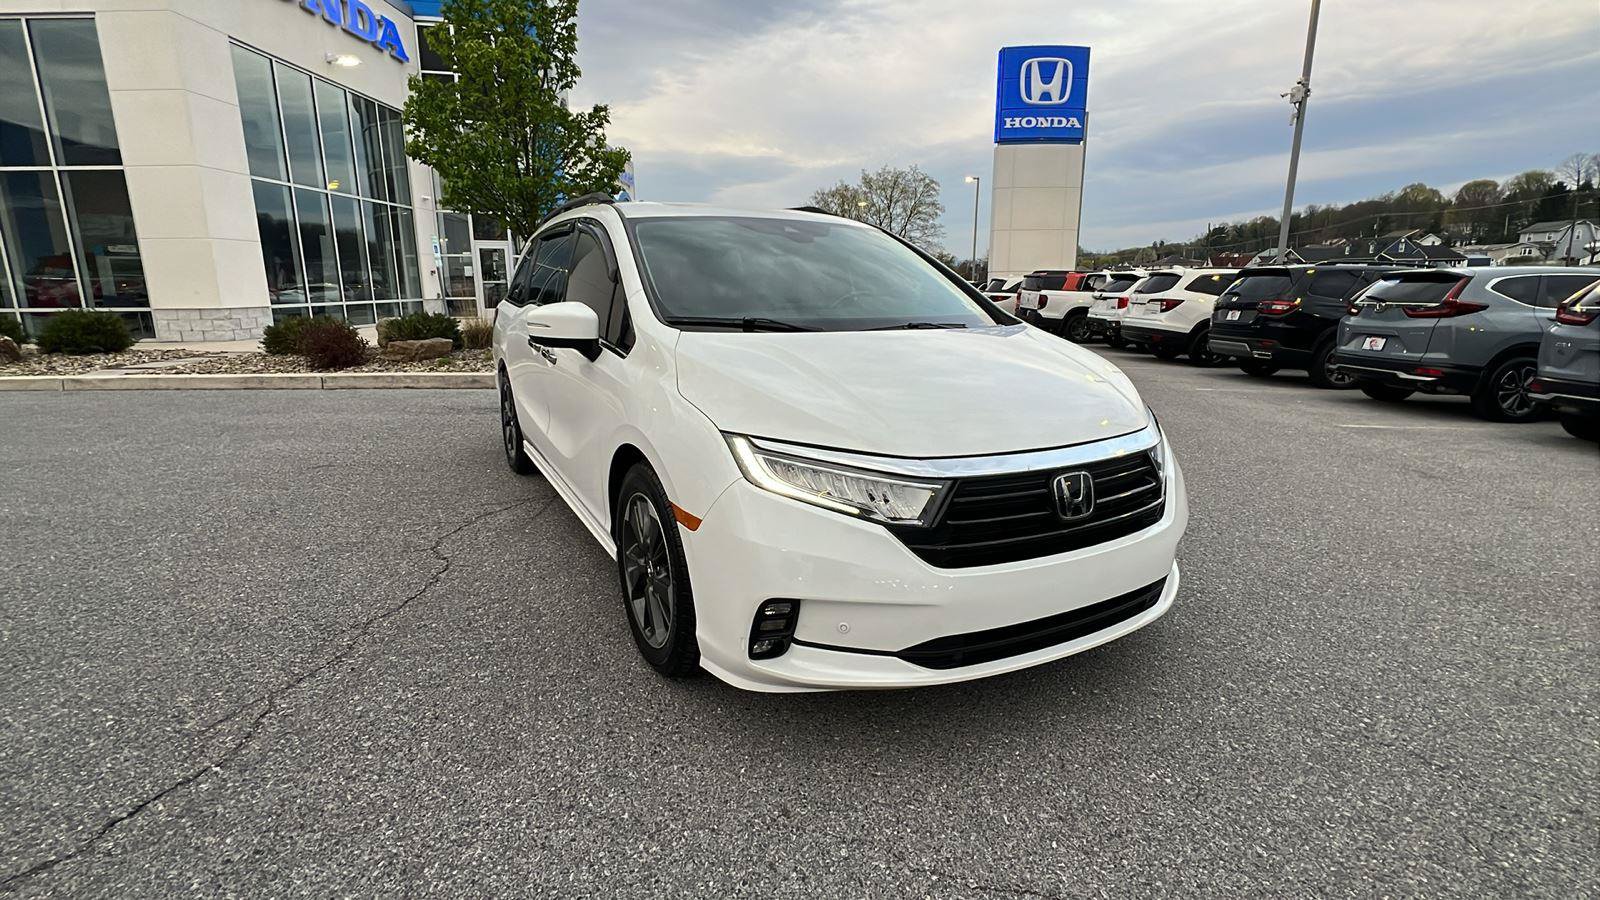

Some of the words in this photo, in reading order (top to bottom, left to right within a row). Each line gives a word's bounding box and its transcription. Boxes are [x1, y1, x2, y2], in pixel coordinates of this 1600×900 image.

[299, 0, 409, 63] NDA
[1030, 59, 1065, 102] H
[1003, 117, 1082, 128] HONDA
